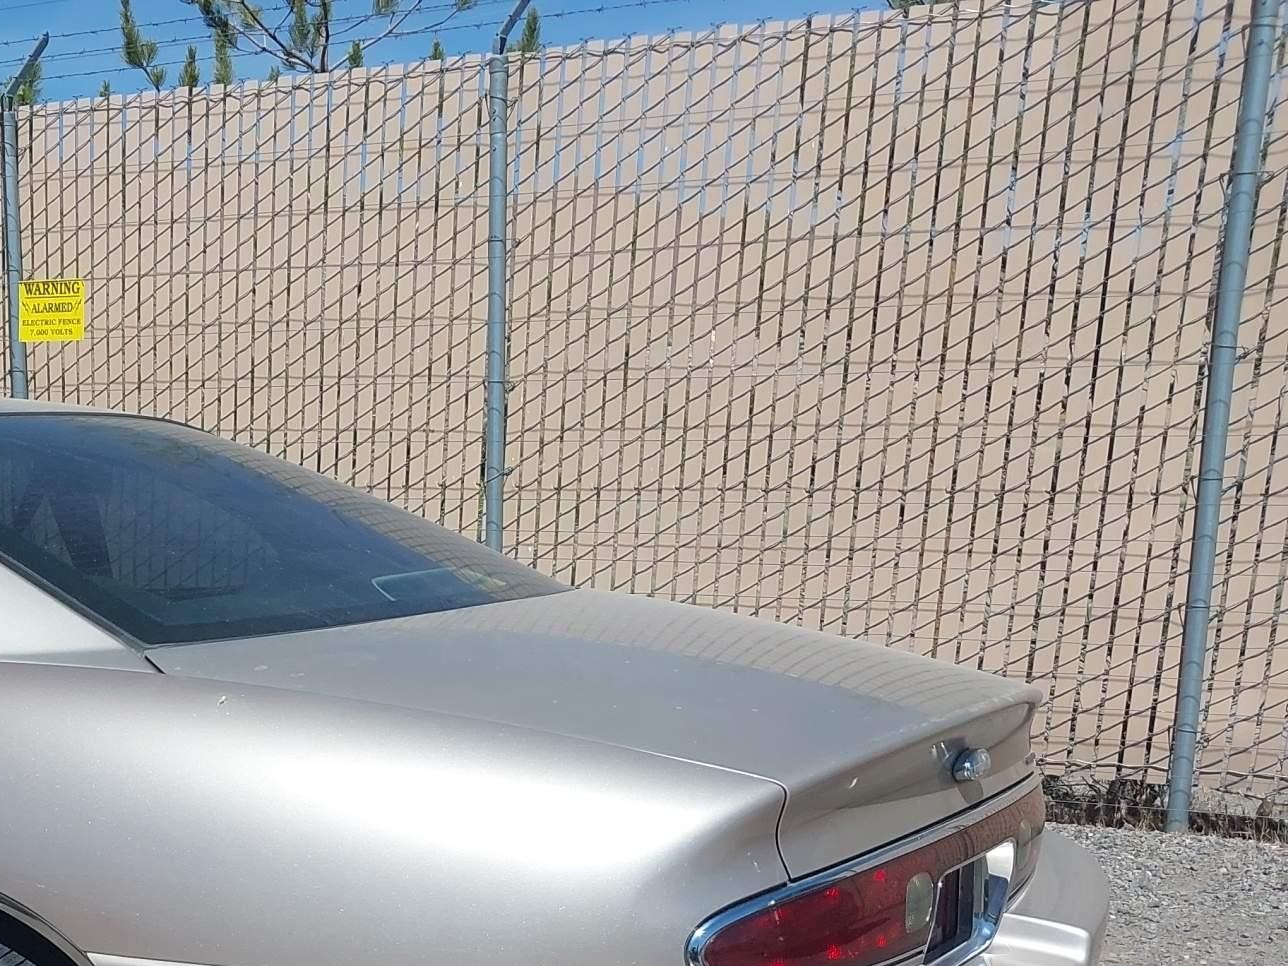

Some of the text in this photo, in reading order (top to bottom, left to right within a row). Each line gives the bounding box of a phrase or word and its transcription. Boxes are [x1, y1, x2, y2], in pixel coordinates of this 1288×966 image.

[24, 281, 81, 296] WARNING
[31, 302, 73, 314] ALARMED
[22, 319, 57, 327] ELECTRIC
